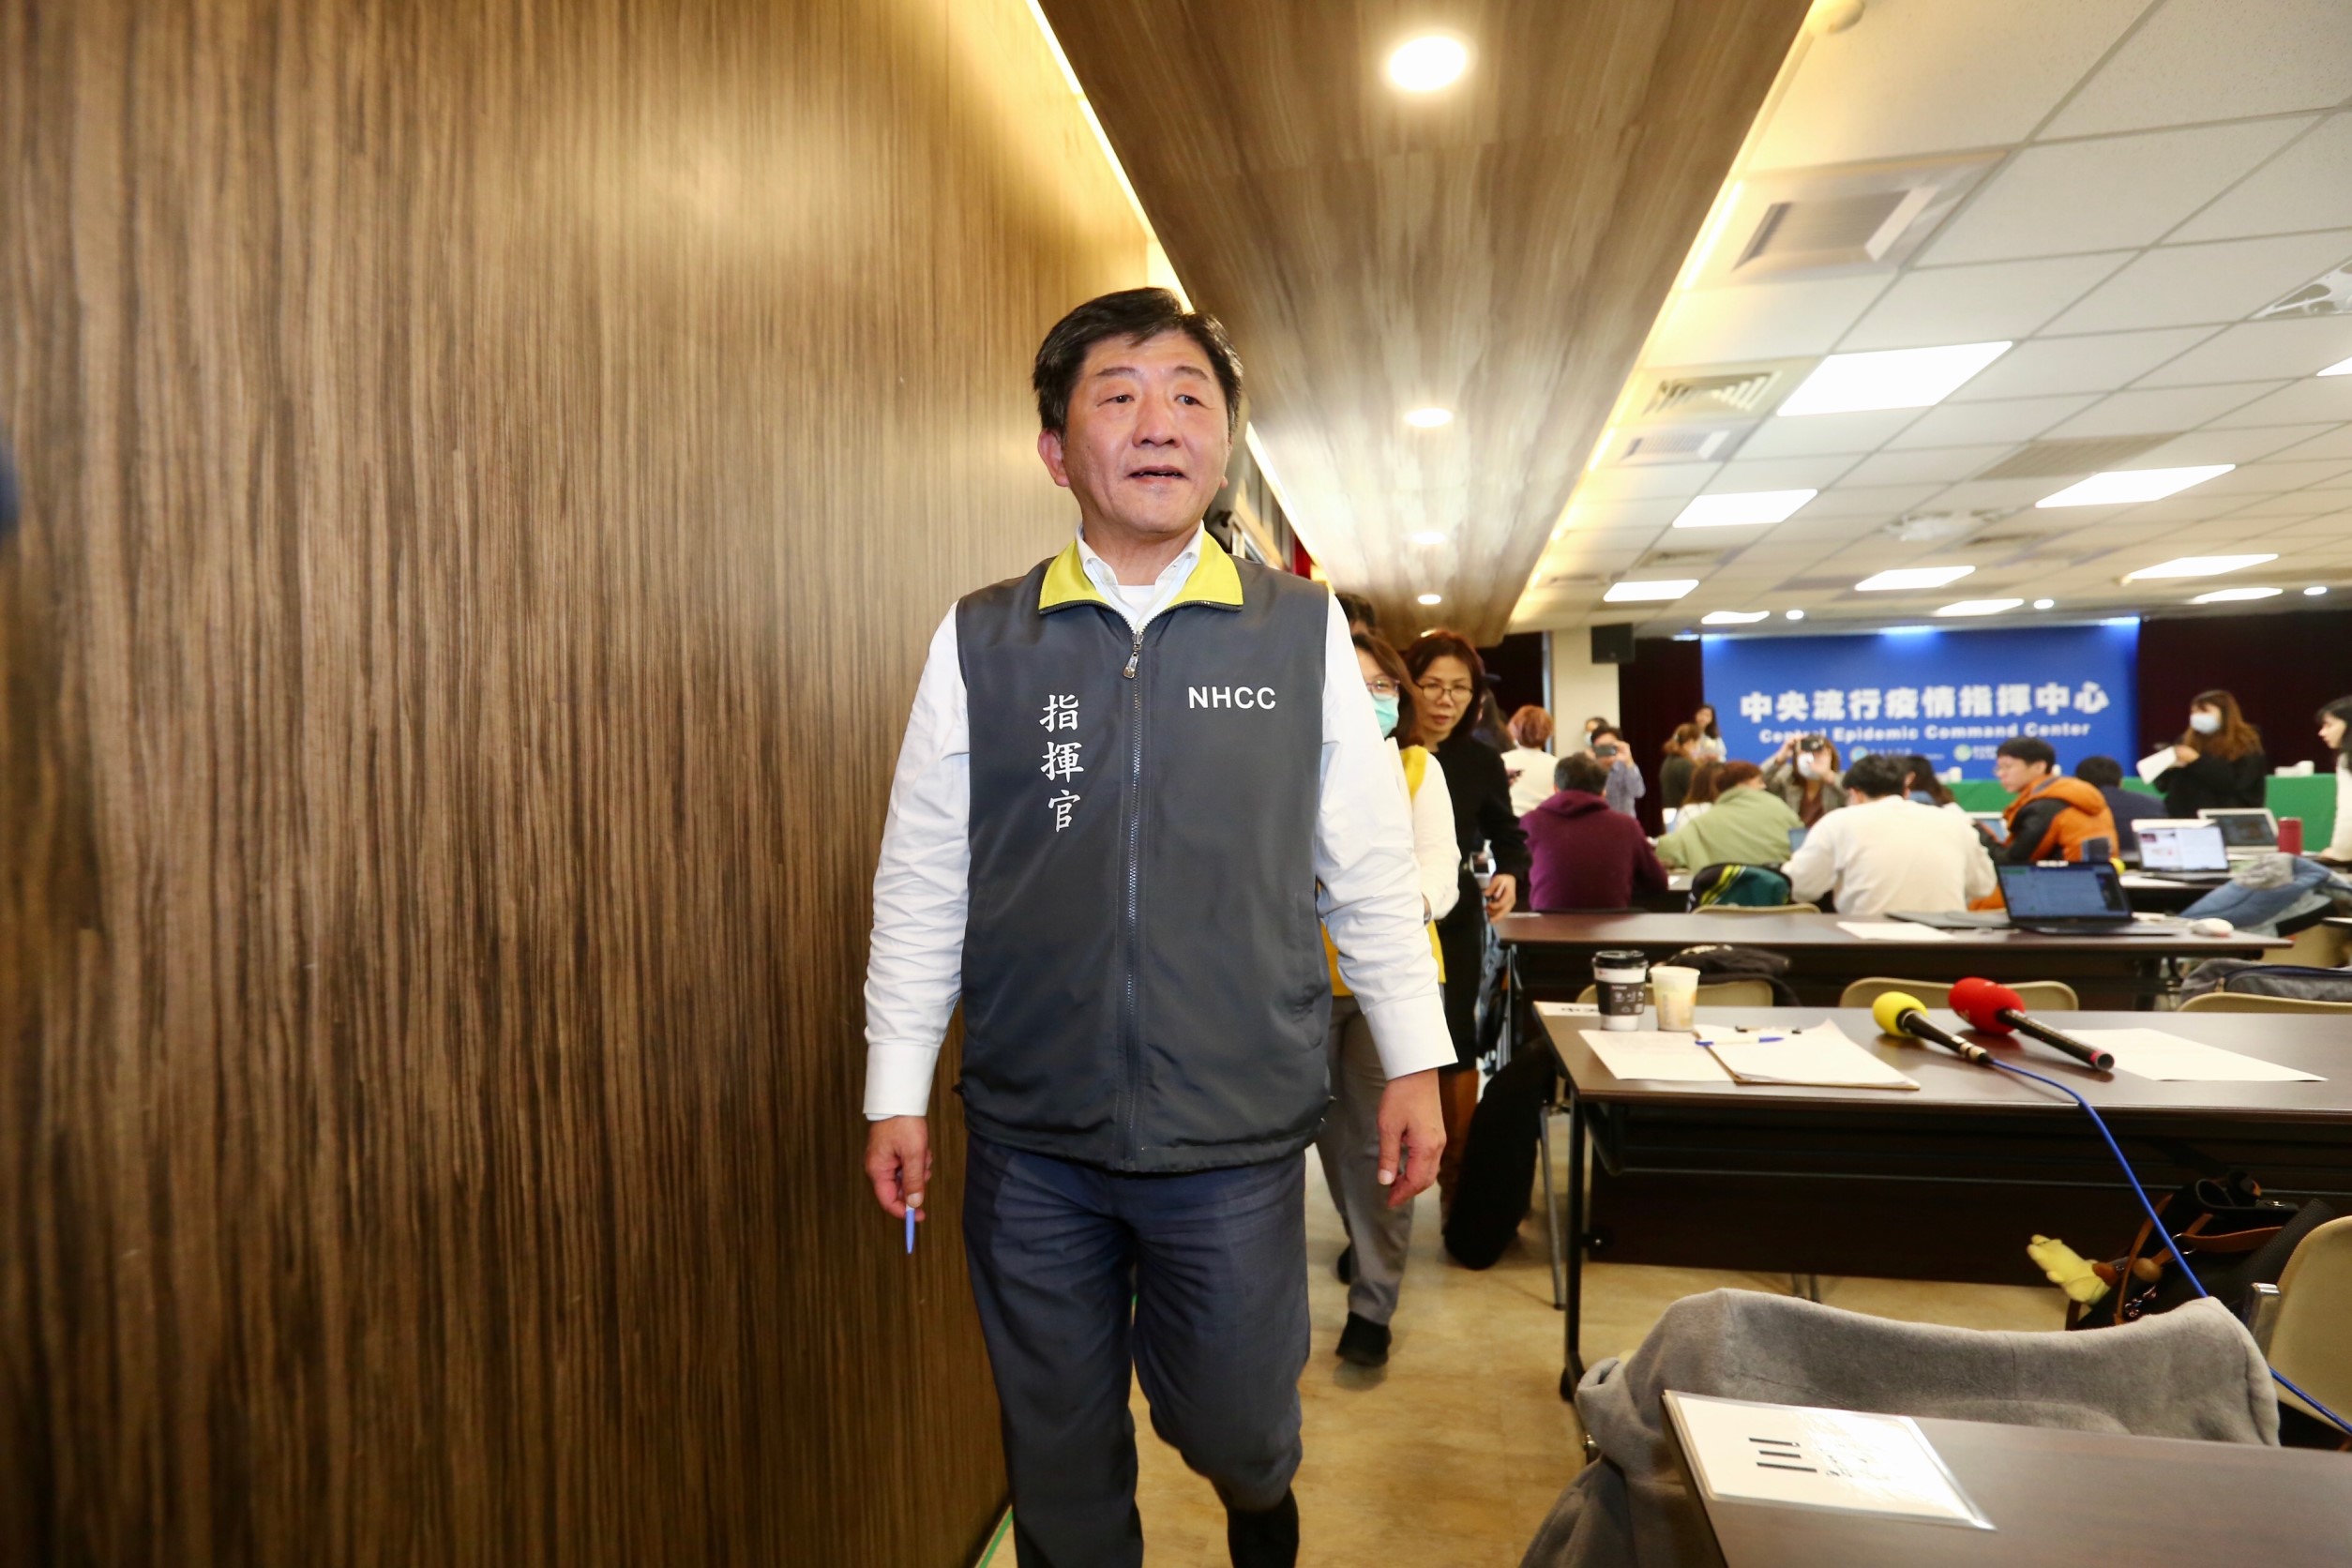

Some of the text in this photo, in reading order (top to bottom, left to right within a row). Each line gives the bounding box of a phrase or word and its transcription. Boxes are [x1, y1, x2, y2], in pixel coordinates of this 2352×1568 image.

[1189, 686, 1275, 709] NHCC
[1740, 682, 2109, 723] 中央流行疫情指揮中心
[1832, 726, 1919, 744] Epidemic
[1923, 723, 2019, 740] Command
[2024, 721, 2091, 738] Center
[1039, 694, 1084, 832] 指揮官
